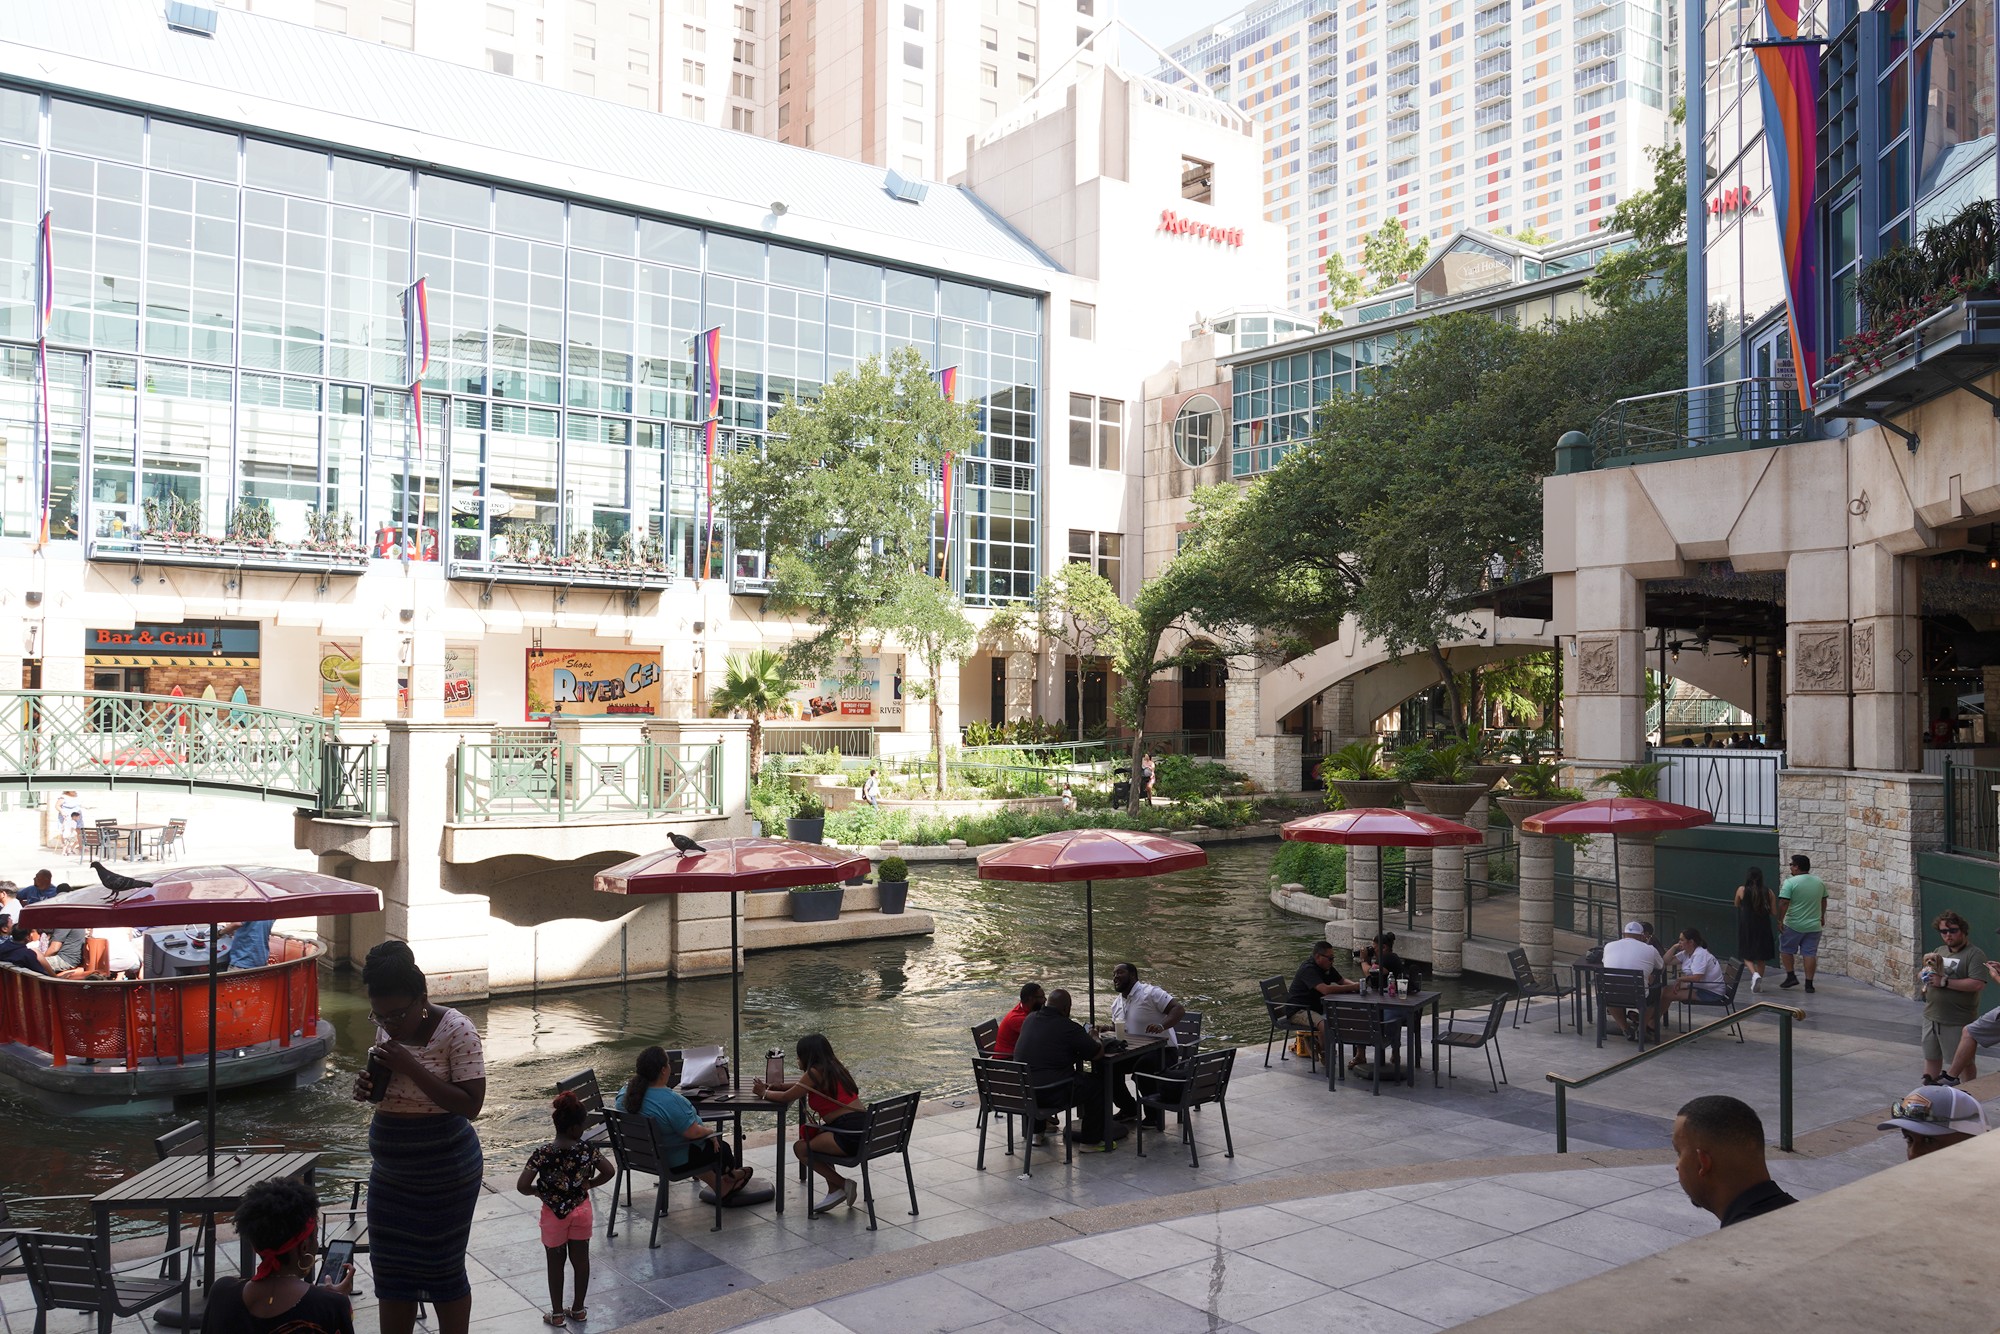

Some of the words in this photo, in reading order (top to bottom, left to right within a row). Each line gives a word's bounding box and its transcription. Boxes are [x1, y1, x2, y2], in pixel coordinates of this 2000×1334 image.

[1463, 264, 1480, 276] Yard
[1481, 259, 1506, 271] House
[96, 629, 133, 645] Bar
[137, 630, 154, 645] &
[159, 631, 207, 646] Grill
[530, 657, 561, 671] Greetings
[566, 659, 592, 669] Shops
[838, 669, 875, 685] HPY
[841, 685, 871, 700] HOUR
